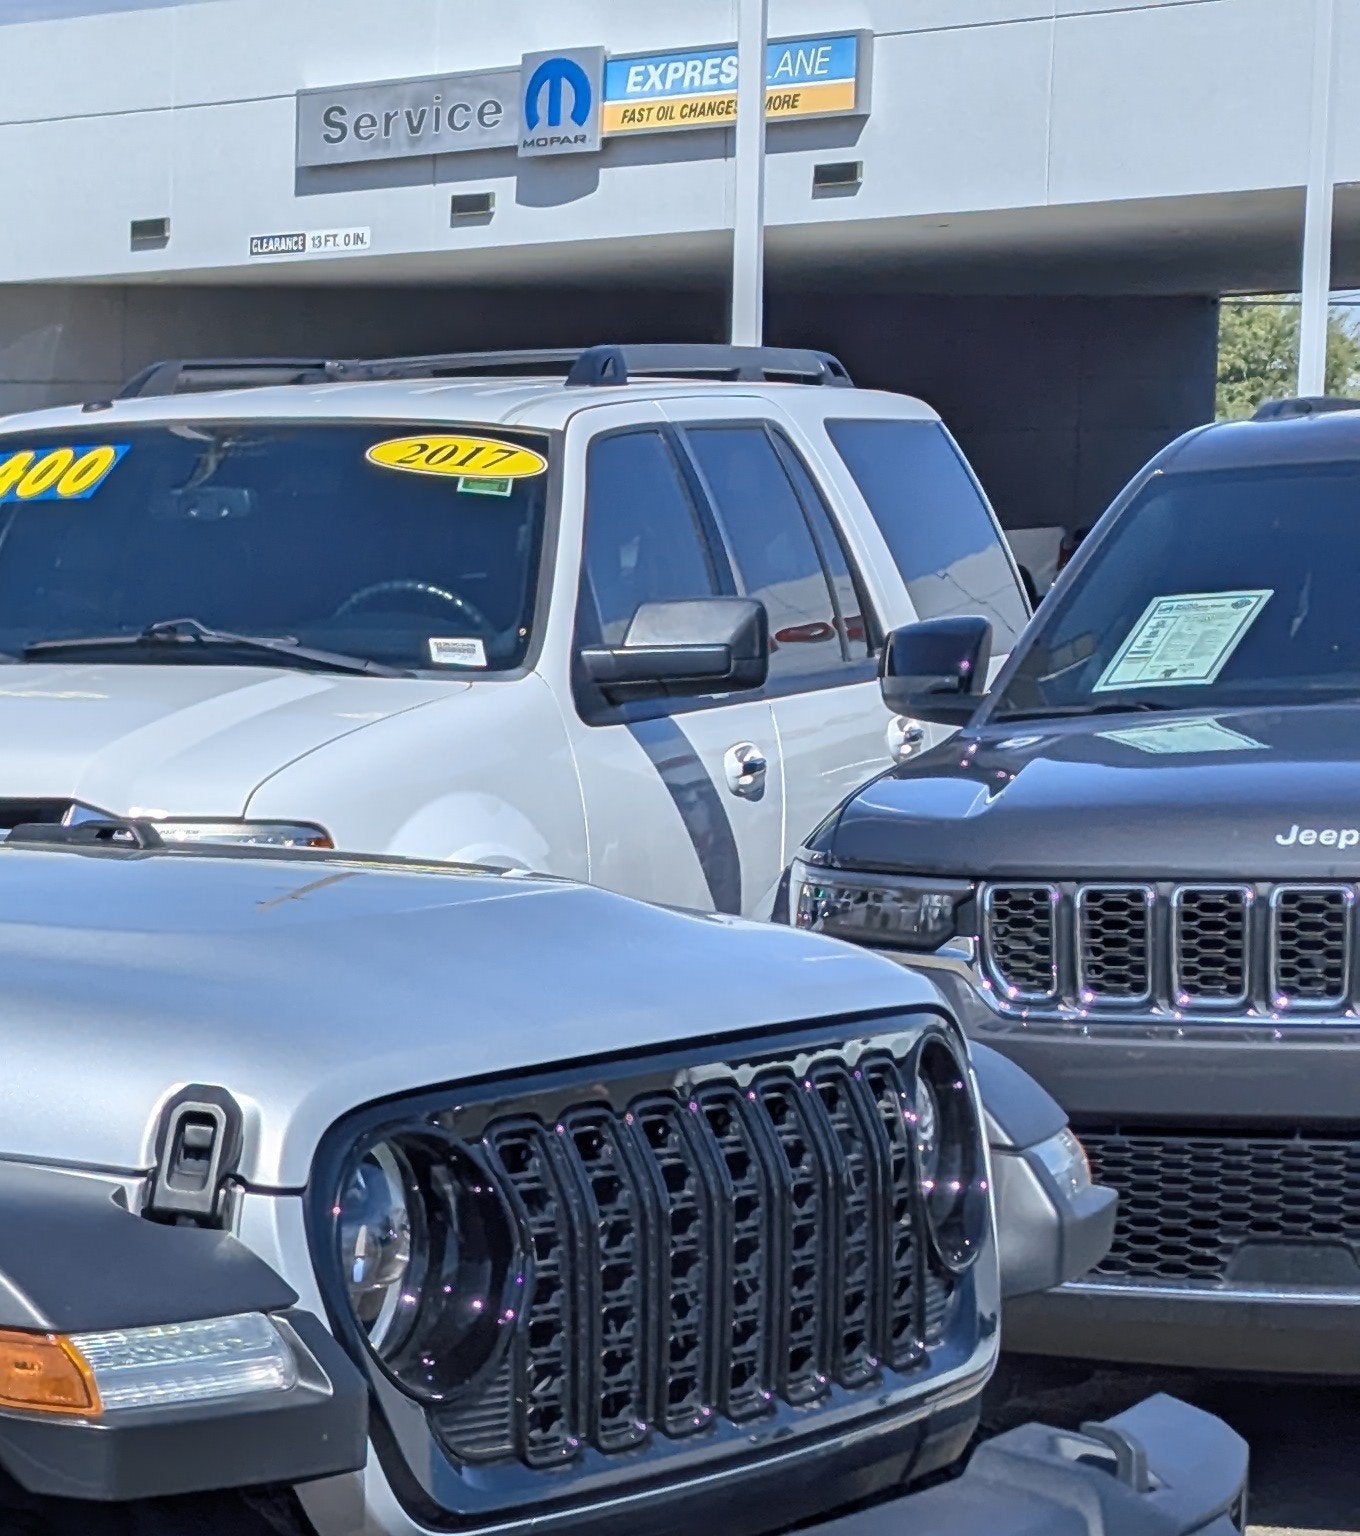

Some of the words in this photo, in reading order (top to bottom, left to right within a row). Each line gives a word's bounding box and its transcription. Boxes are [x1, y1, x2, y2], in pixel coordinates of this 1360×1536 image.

[625, 55, 738, 94] EXPRES
[766, 45, 833, 79] ANE
[322, 94, 503, 145] Service
[621, 106, 653, 124] FAST
[656, 104, 676, 121] OIL
[522, 133, 588, 149] MOPAR
[252, 235, 304, 253] CLEARANCE
[311, 235, 323, 249] 13
[395, 438, 522, 473] 2017
[1274, 824, 1360, 849] Jeep
